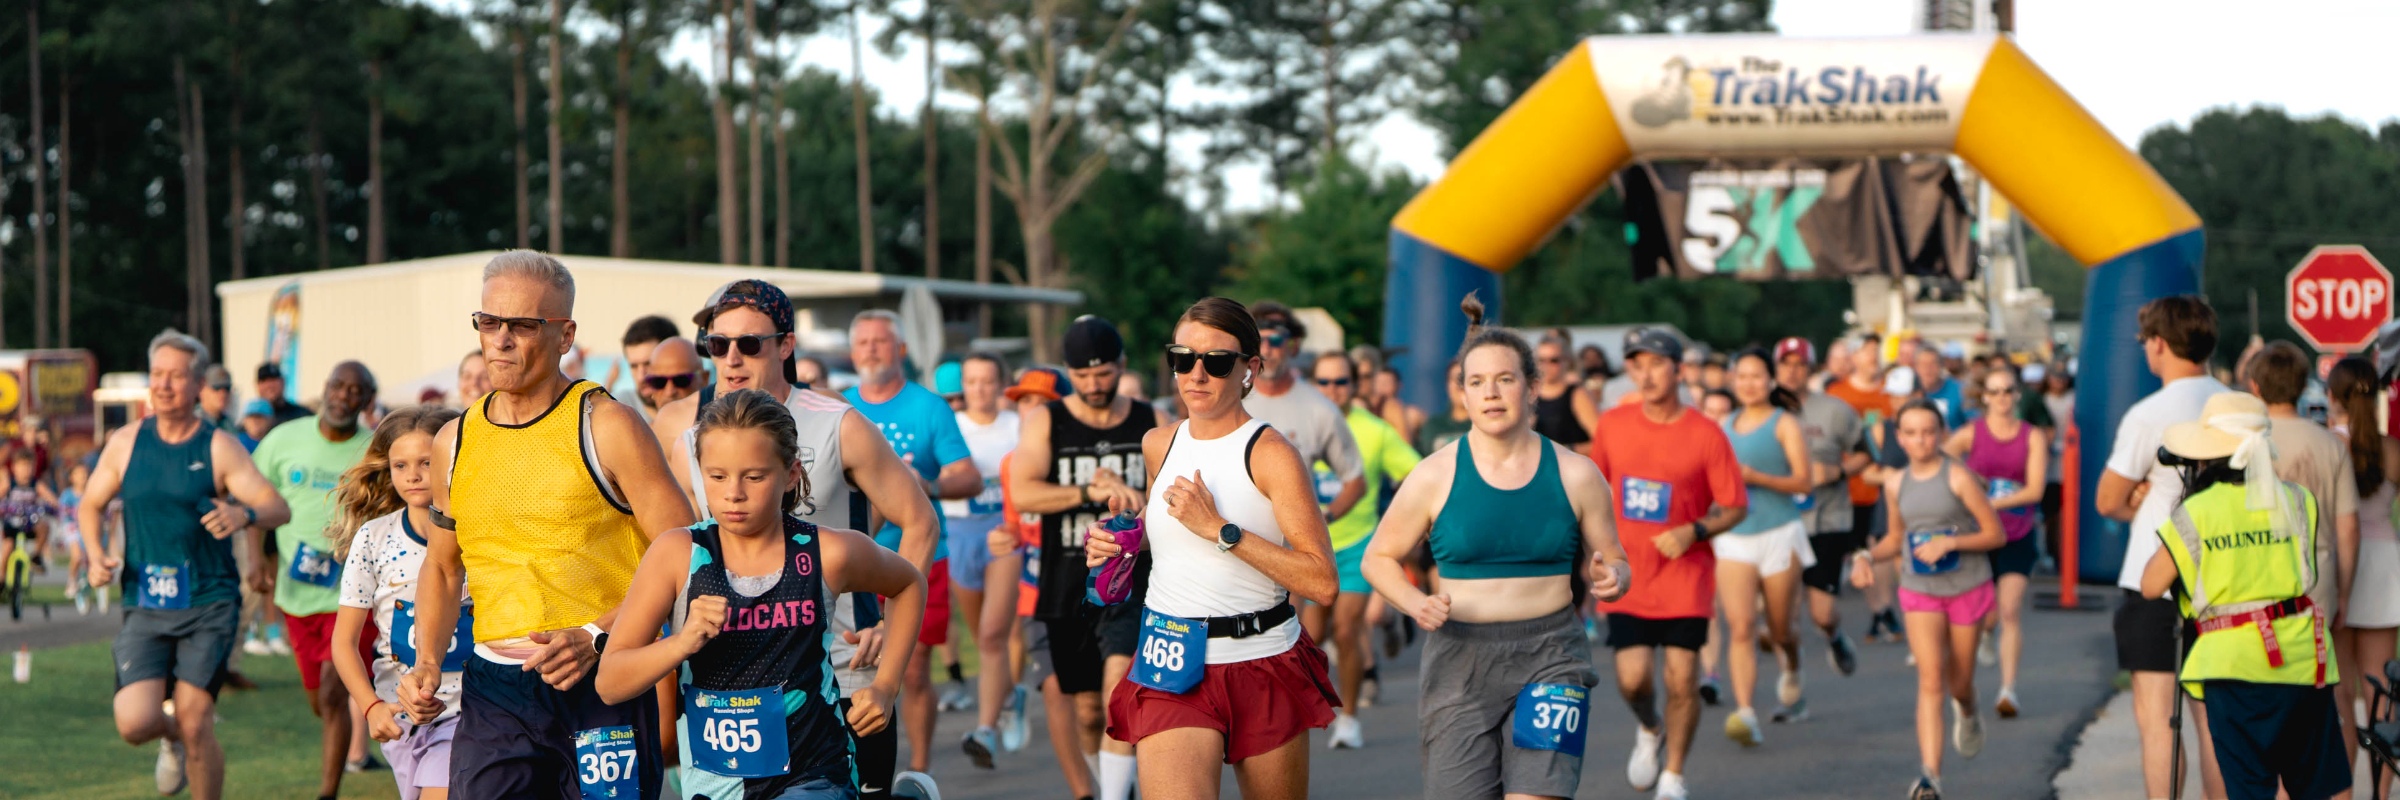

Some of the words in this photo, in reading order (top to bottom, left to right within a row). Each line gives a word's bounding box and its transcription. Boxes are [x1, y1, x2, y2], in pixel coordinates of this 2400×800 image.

[1681, 185, 1825, 274] 5K
[2296, 278, 2385, 320] STOP
[1626, 489, 1659, 512] 345
[796, 552, 813, 576] 8
[148, 576, 179, 598] 346
[723, 599, 815, 632] LDCATS
[1166, 620, 1190, 633] Shak
[1142, 635, 1185, 672] 468
[729, 695, 761, 708] Shak
[1533, 702, 1580, 733] 370
[703, 717, 762, 753] 465
[580, 750, 637, 785] 367
